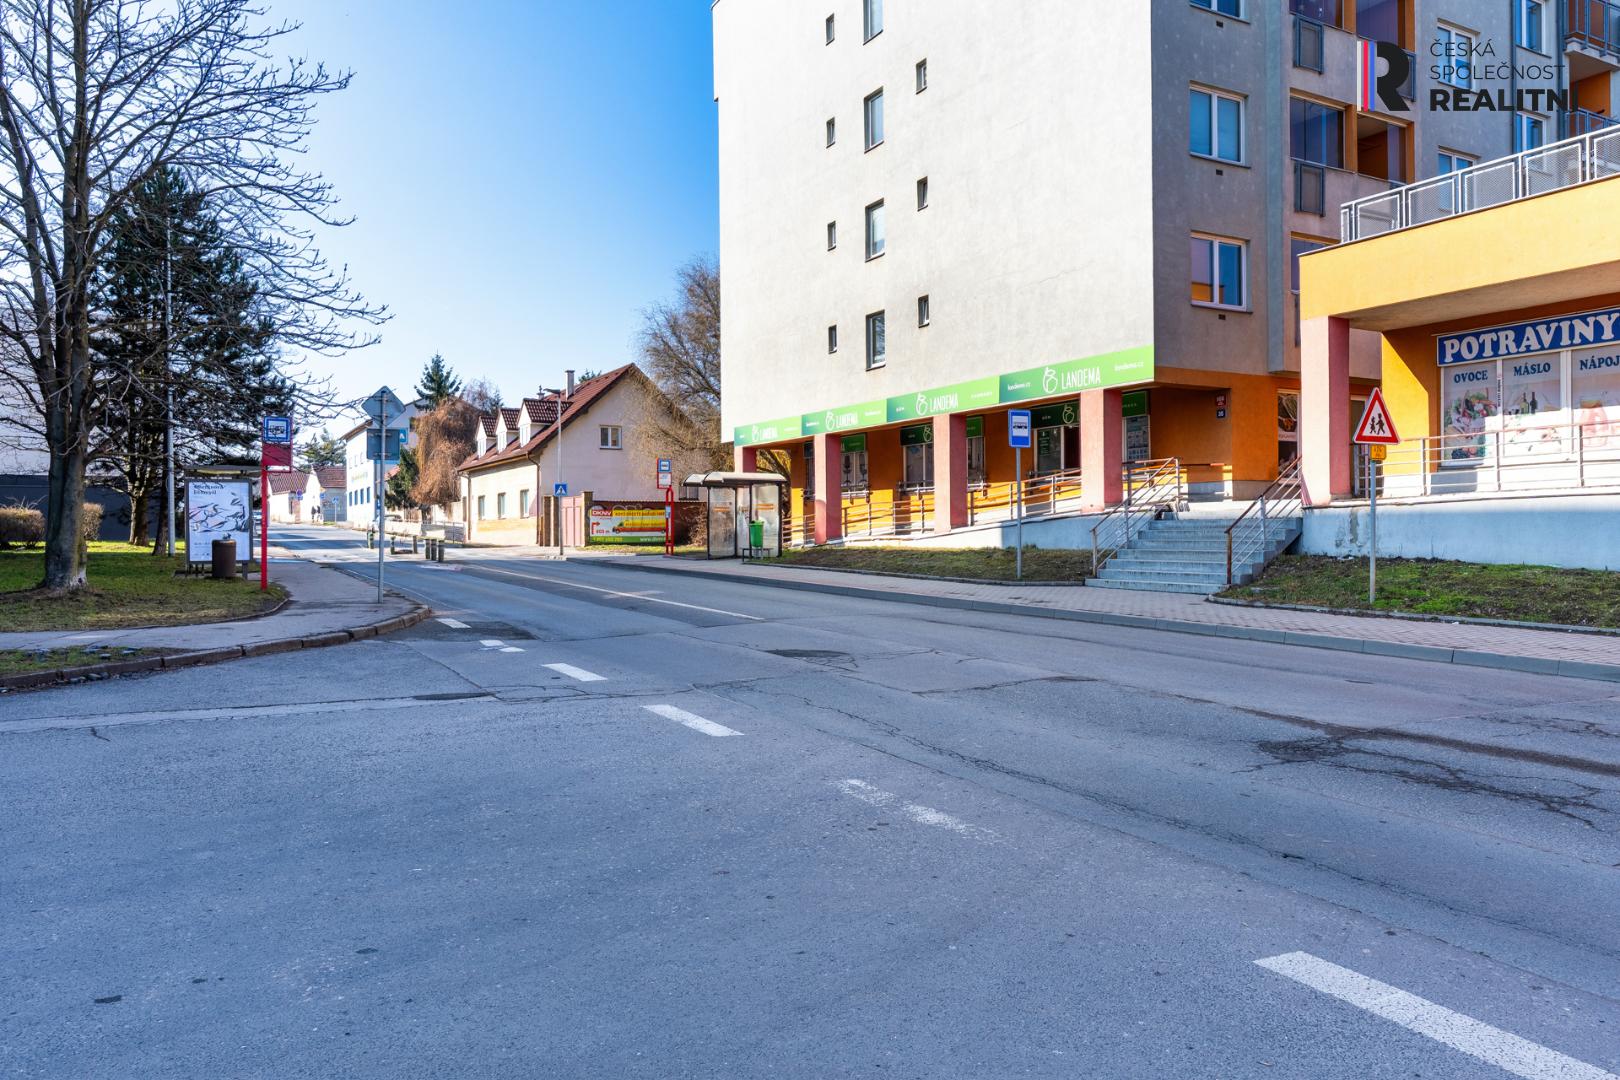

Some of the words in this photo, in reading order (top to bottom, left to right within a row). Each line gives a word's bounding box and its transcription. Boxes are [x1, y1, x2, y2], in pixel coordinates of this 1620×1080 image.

[1443, 312, 1620, 364] POTRAVINY
[1061, 367, 1101, 390] LANDEMA
[1453, 369, 1489, 384] OVOCE
[1513, 362, 1551, 377] MÁSLO
[929, 392, 959, 412] LANDEMA
